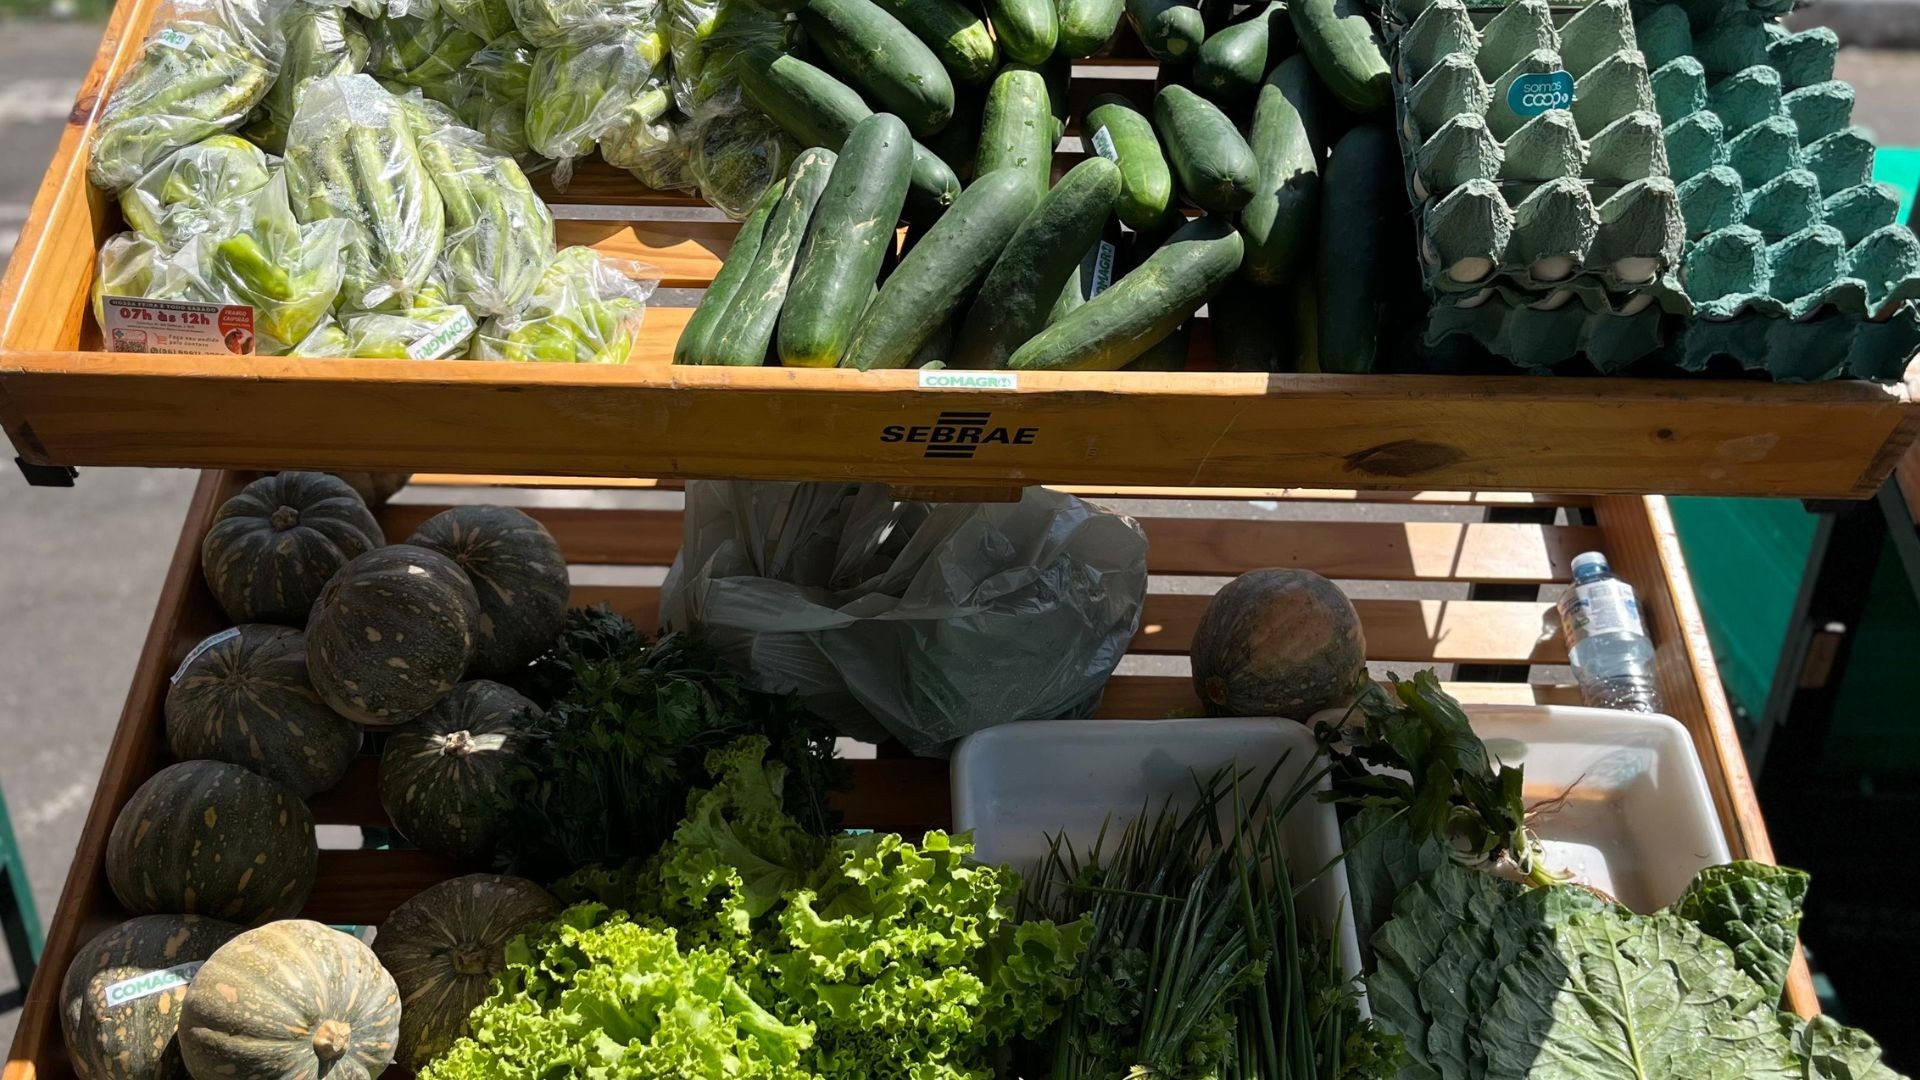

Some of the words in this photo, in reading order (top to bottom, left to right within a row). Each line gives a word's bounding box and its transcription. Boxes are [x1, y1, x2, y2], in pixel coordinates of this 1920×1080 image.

[1524, 81, 1562, 93] somos
[120, 307, 152, 320] 07h
[157, 310, 176, 322] às
[181, 312, 210, 325] 12h
[925, 376, 1011, 387] COMAGRO
[880, 425, 1039, 444] SEBRAE
[112, 966, 198, 1000] COMAGRO
